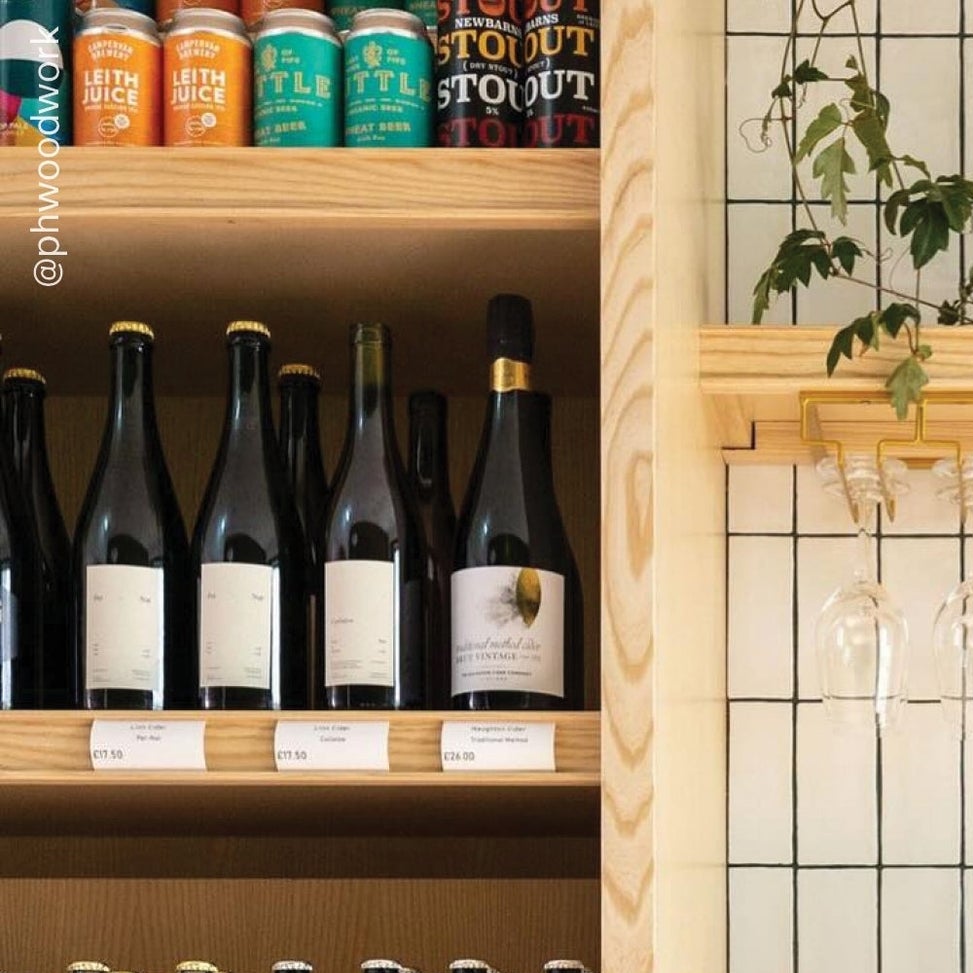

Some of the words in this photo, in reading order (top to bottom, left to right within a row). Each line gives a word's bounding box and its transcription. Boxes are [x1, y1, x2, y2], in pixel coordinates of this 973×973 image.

[84, 68, 139, 89] LEITH
[173, 67, 226, 86] LEITH
[82, 86, 139, 106] JUICE
[172, 85, 226, 104] JUICE
